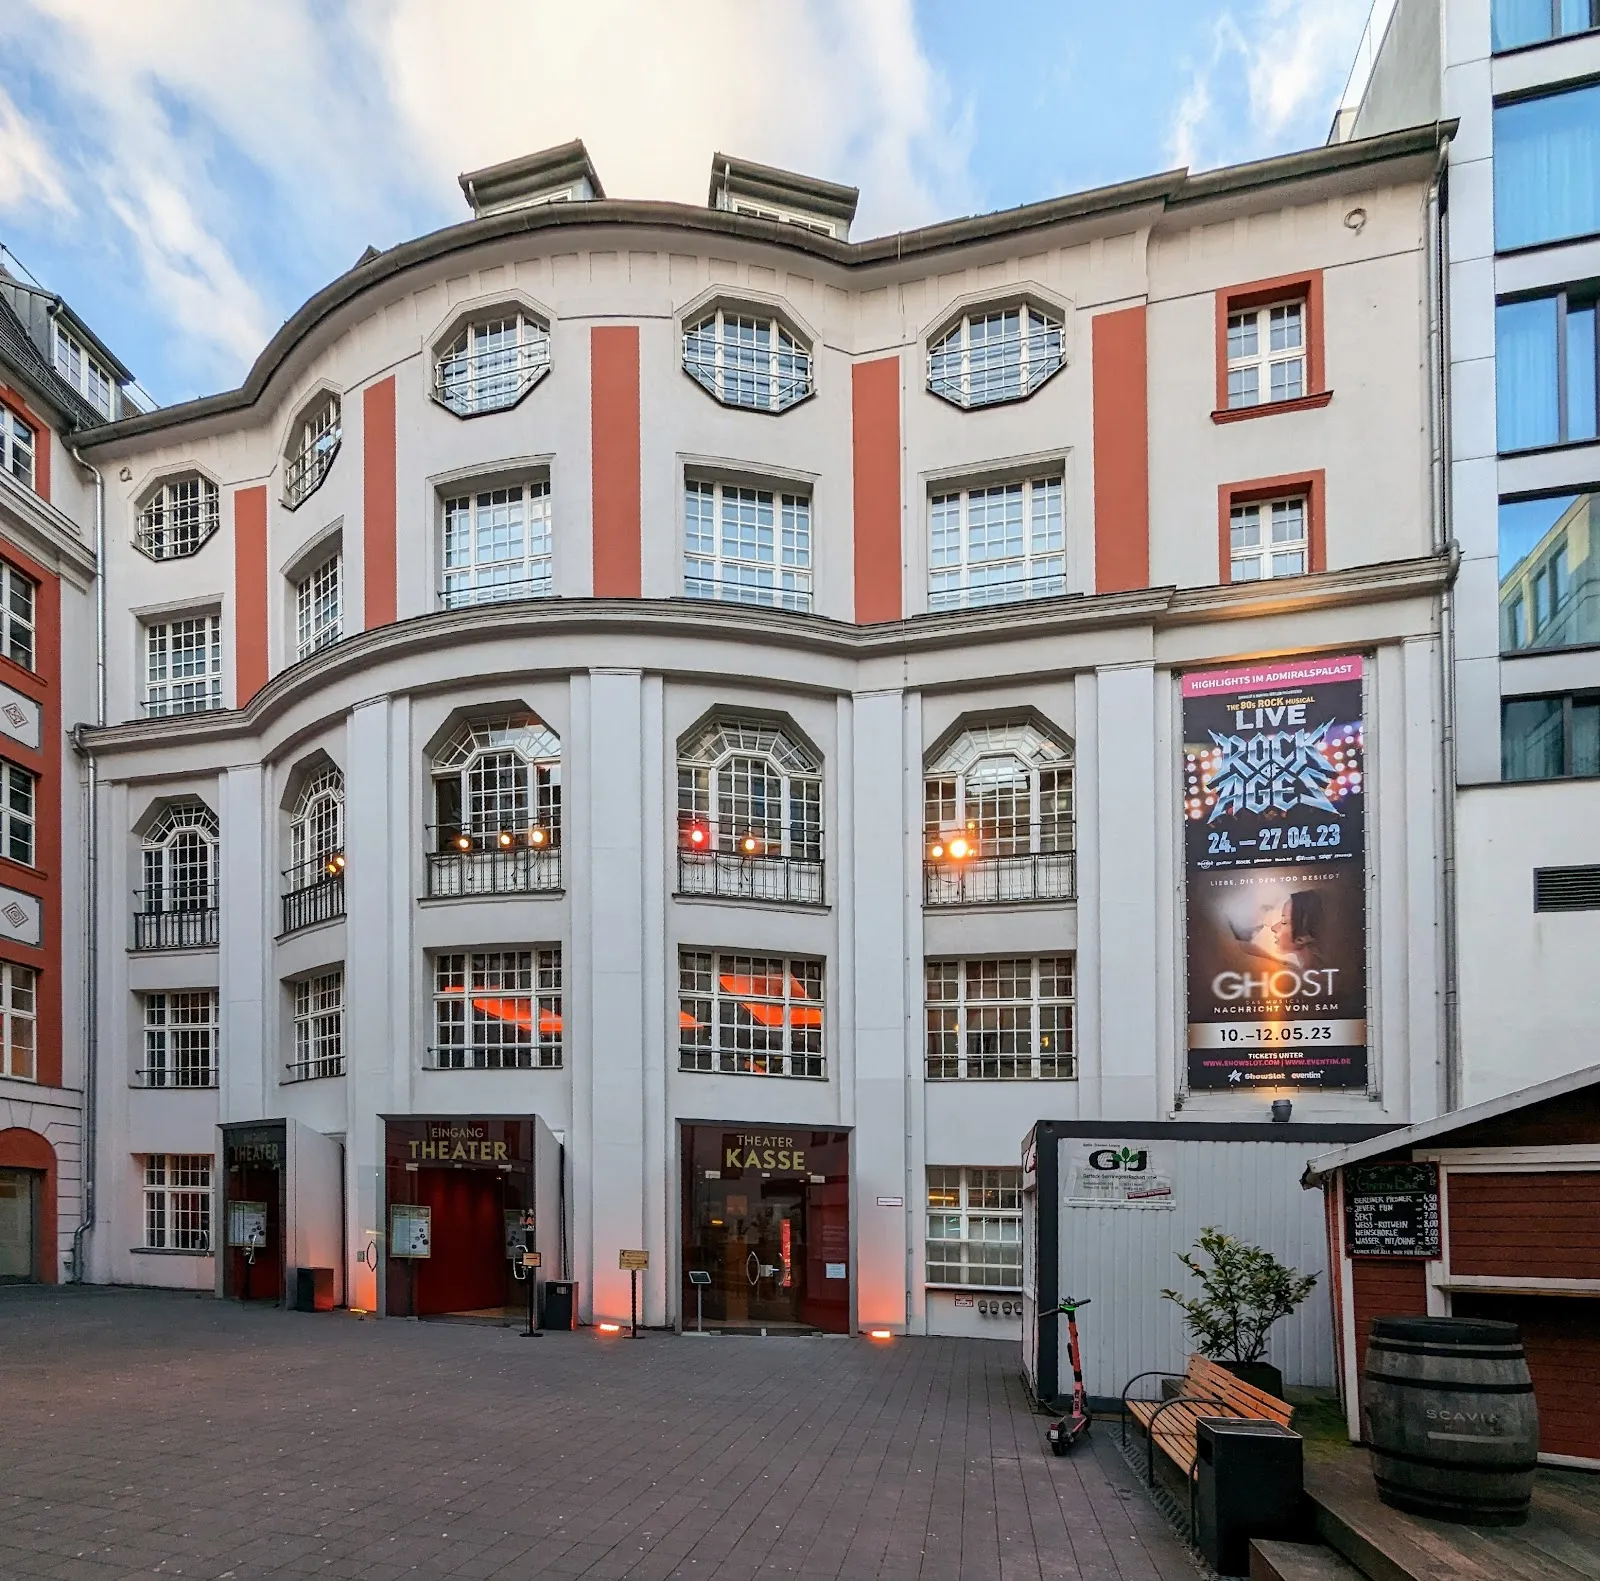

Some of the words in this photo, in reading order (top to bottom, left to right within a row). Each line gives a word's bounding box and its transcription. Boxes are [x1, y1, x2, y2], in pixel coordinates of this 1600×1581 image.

[1191, 675, 1250, 690] HIGHLIGHTS
[1252, 673, 1264, 683] IM
[1266, 664, 1353, 682] ADMIRALSPALAST
[1240, 700, 1256, 710] 80s
[1257, 697, 1284, 708] ROCK
[1285, 696, 1316, 705] MUSICAL
[1236, 703, 1306, 730] LIVE
[1206, 717, 1338, 785] ROCK
[1260, 762, 1281, 779] OF
[1206, 767, 1340, 824] AGES
[1302, 873, 1340, 881] BESIEGT
[1211, 968, 1340, 1000] GHOST
[1213, 1004, 1280, 1014] NACHRICHT
[1285, 1003, 1309, 1012] VON
[1315, 1003, 1339, 1011] SAM
[1203, 1059, 1280, 1067] WWW.SHOWSLOT.COM
[1285, 1058, 1351, 1066] WWW.EVENTIM.DE
[1248, 1052, 1278, 1060] TICKETS
[1291, 1070, 1321, 1079] eventim
[431, 1127, 484, 1138] EINGANG
[736, 1134, 794, 1148] THEATER
[233, 1143, 279, 1162] THEATER
[408, 1140, 509, 1161] THEATER
[726, 1148, 806, 1171] KASSE
[1423, 1193, 1438, 1203] 4,50
[1354, 1204, 1376, 1213] JEVER
[1379, 1204, 1394, 1212] FUN
[1423, 1203, 1438, 1212] 4,50
[1354, 1212, 1374, 1222] SEKT
[1354, 1236, 1381, 1245] WASSER
